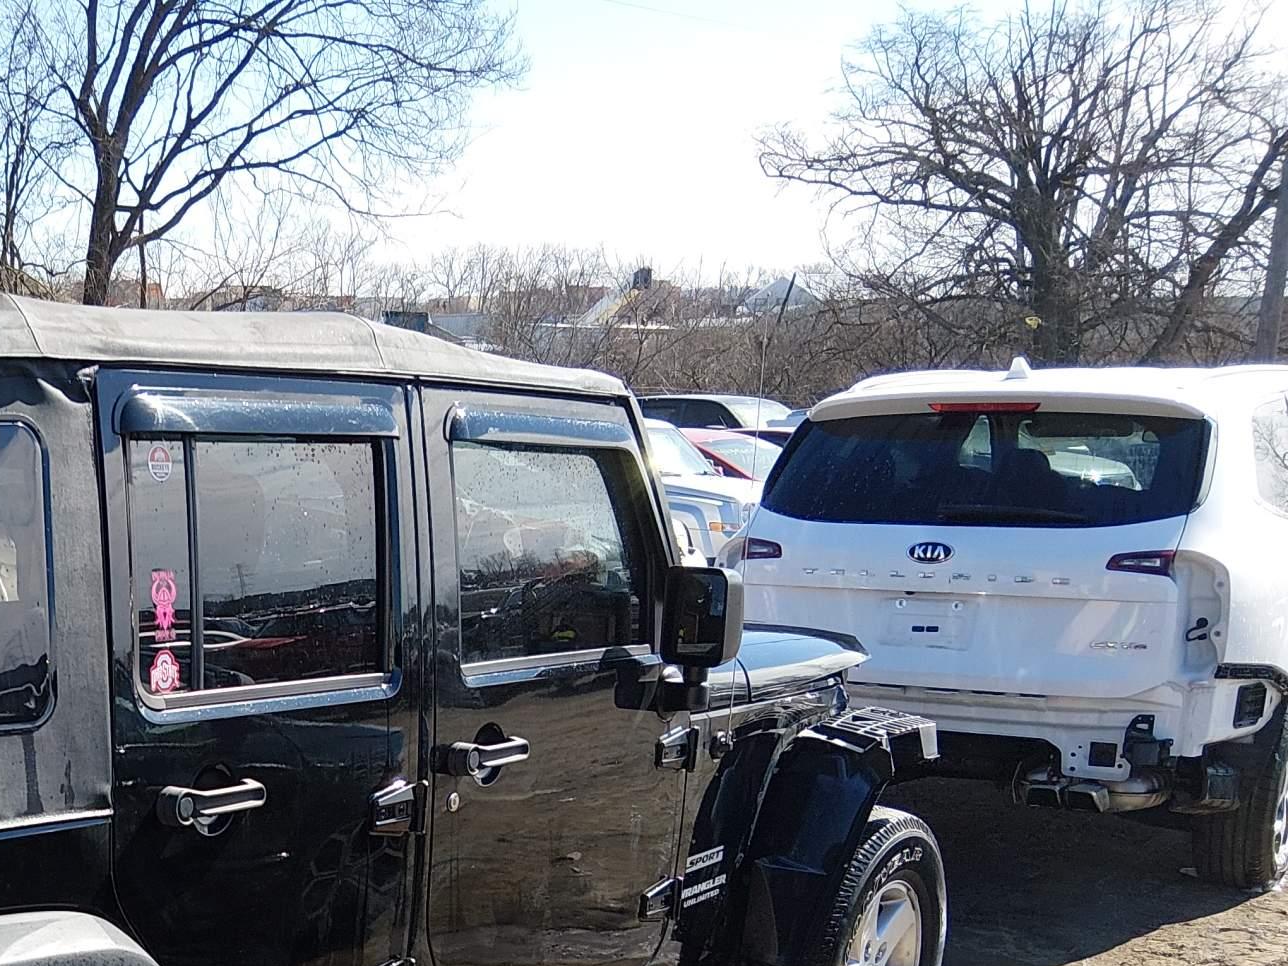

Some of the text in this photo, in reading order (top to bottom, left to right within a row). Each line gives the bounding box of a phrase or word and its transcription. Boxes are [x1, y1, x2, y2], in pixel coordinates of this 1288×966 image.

[913, 545, 945, 559] KIA
[689, 850, 721, 867] SPORT
[683, 888, 720, 908] UNLIMITED
